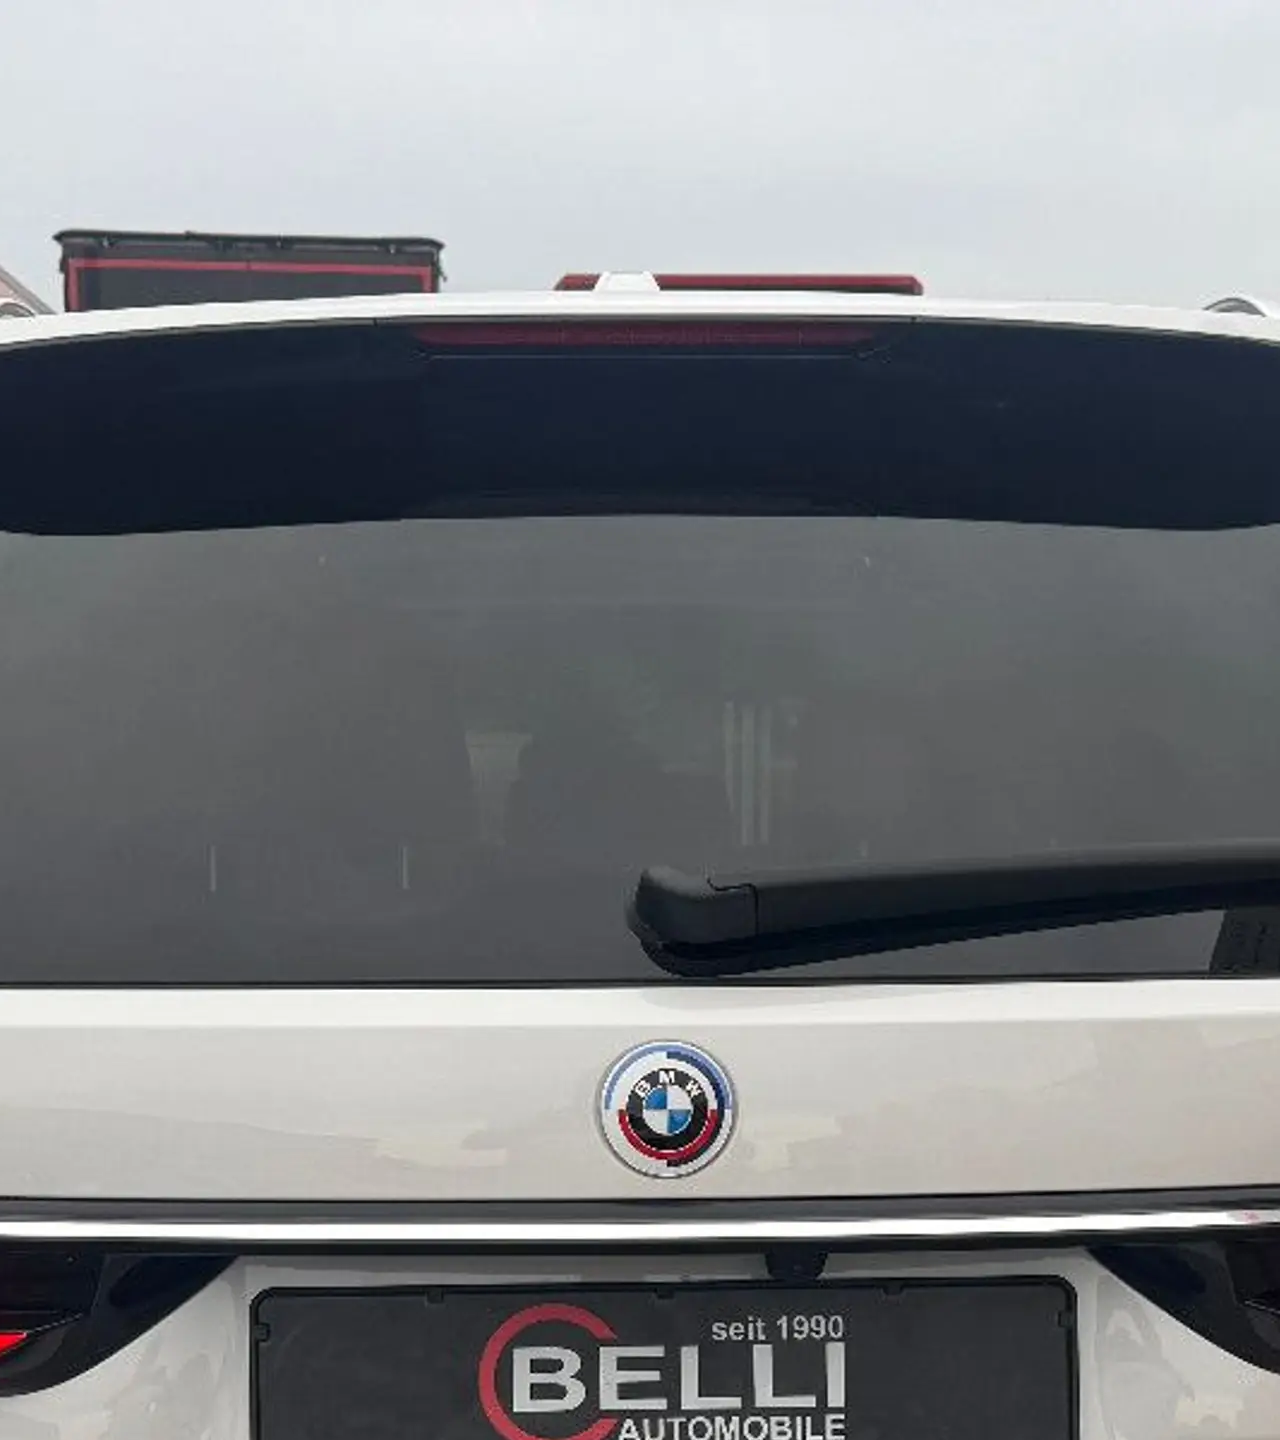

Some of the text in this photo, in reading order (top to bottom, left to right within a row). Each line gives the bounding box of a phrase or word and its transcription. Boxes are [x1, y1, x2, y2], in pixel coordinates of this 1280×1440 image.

[712, 1315, 844, 1341] seit 1990
[512, 1342, 846, 1412] BELLI
